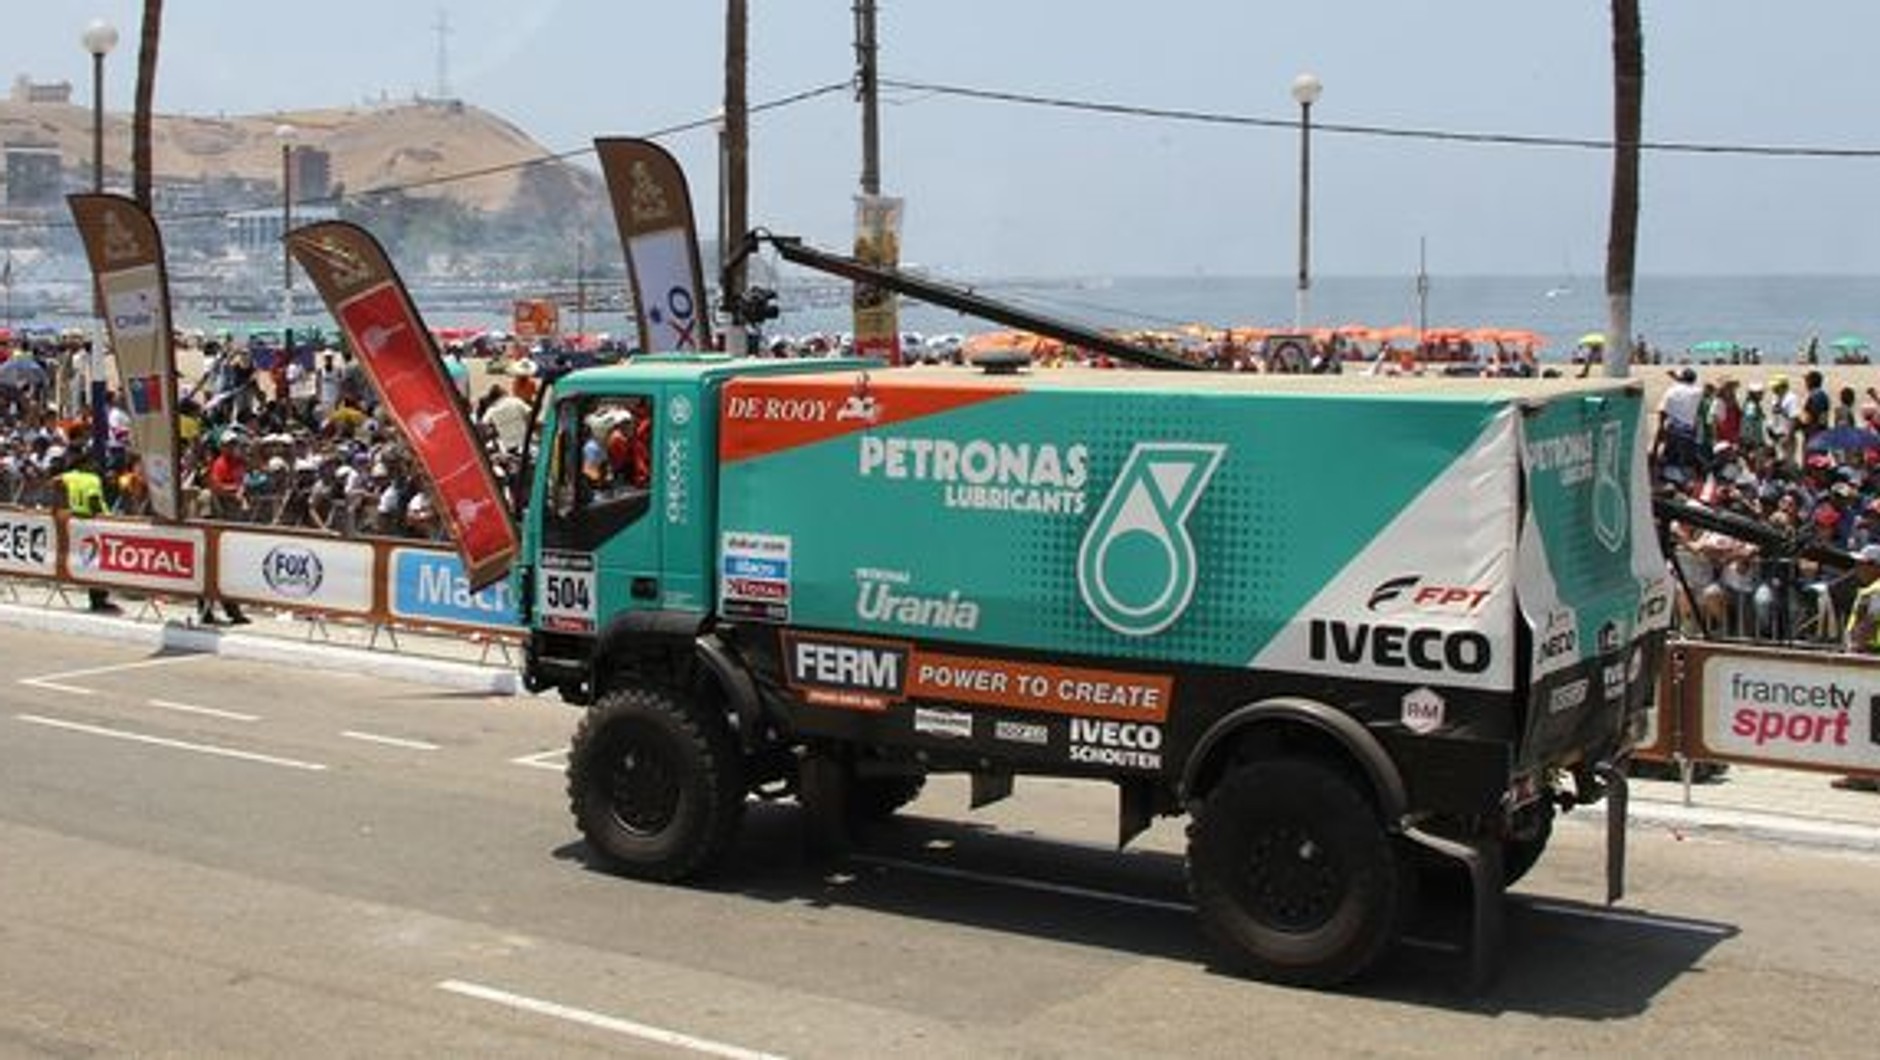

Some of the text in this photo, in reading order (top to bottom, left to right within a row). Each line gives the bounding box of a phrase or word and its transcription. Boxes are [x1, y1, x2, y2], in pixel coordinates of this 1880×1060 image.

[728, 397, 831, 421] DE ROOY
[858, 436, 1088, 489] PETRONAS
[945, 485, 1086, 514] LUBRICANTS
[104, 538, 191, 573] TOTAL
[275, 553, 310, 579] FOX
[548, 575, 590, 611] 504
[856, 581, 980, 630] Urania
[1414, 587, 1490, 609] FPT
[1309, 619, 1491, 674] IVECO
[797, 642, 897, 689] FERM
[918, 665, 1160, 710] POWER TO CREATE
[1731, 672, 1855, 709] francetv
[1069, 717, 1162, 750] IVECO
[1731, 707, 1850, 746] sport
